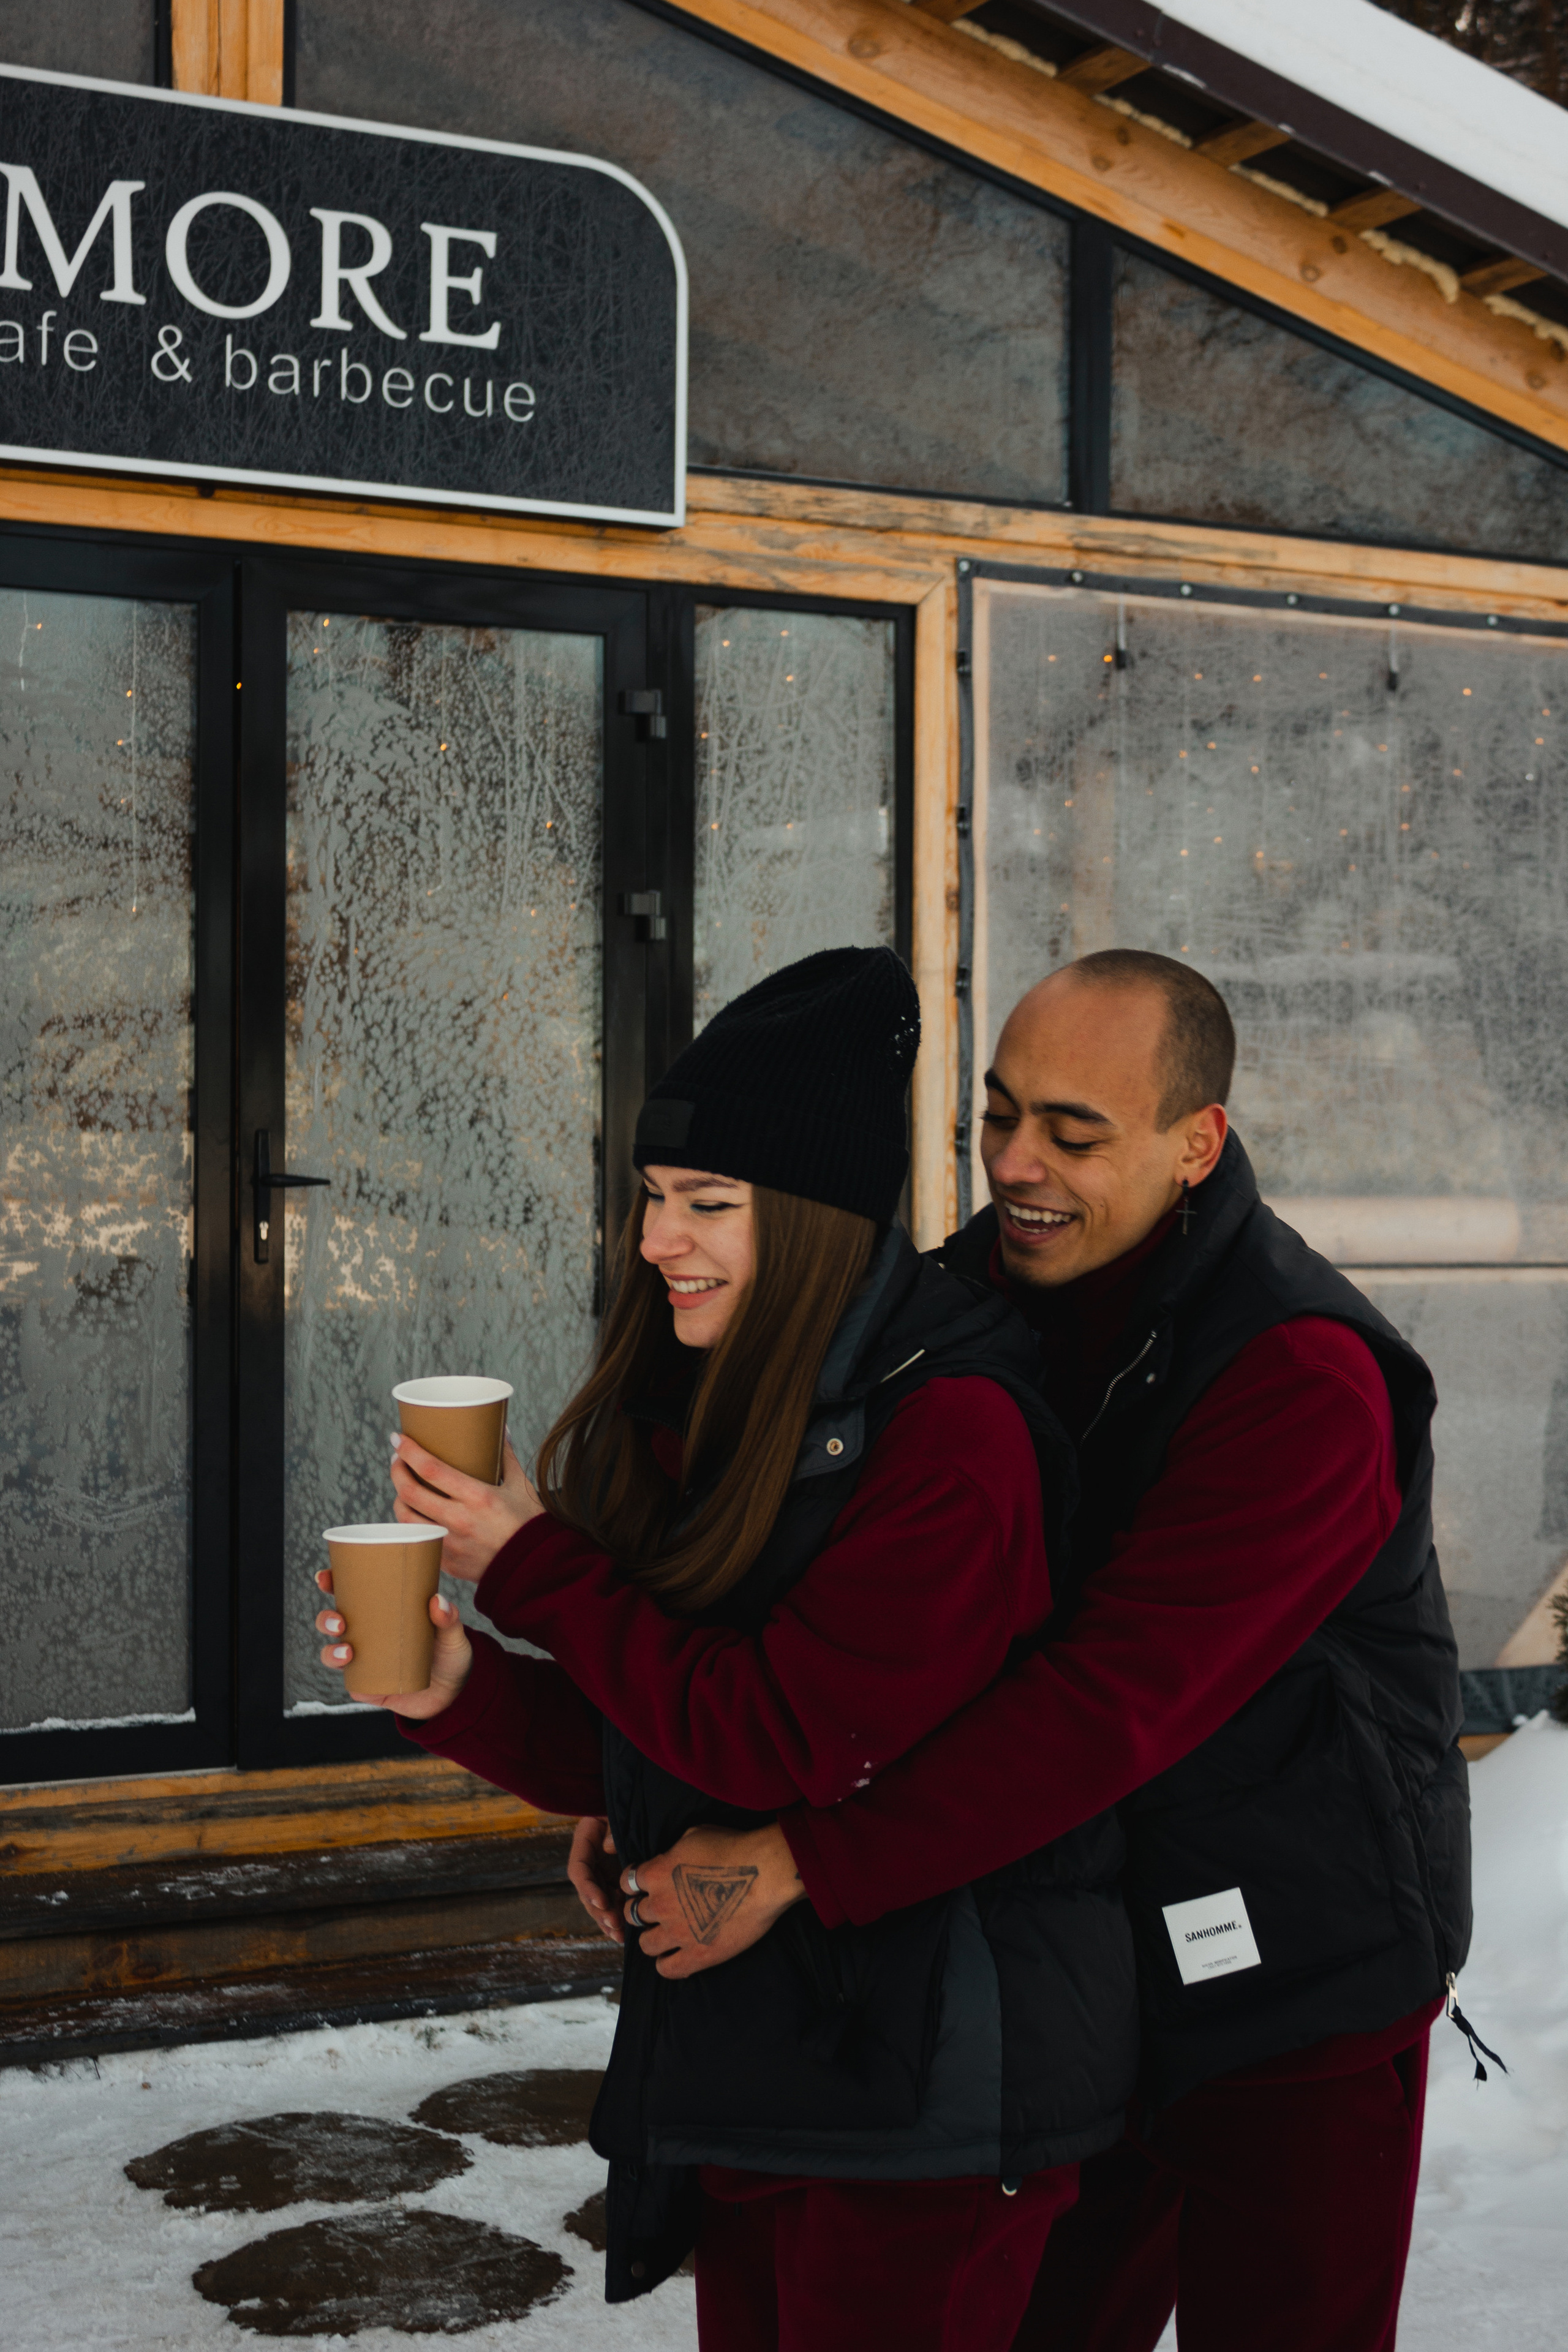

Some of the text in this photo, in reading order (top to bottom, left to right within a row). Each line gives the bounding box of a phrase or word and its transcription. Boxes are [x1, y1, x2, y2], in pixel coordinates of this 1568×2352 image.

[0, 162, 502, 350] MORE
[151, 325, 193, 383] &
[225, 333, 537, 423] barbecue
